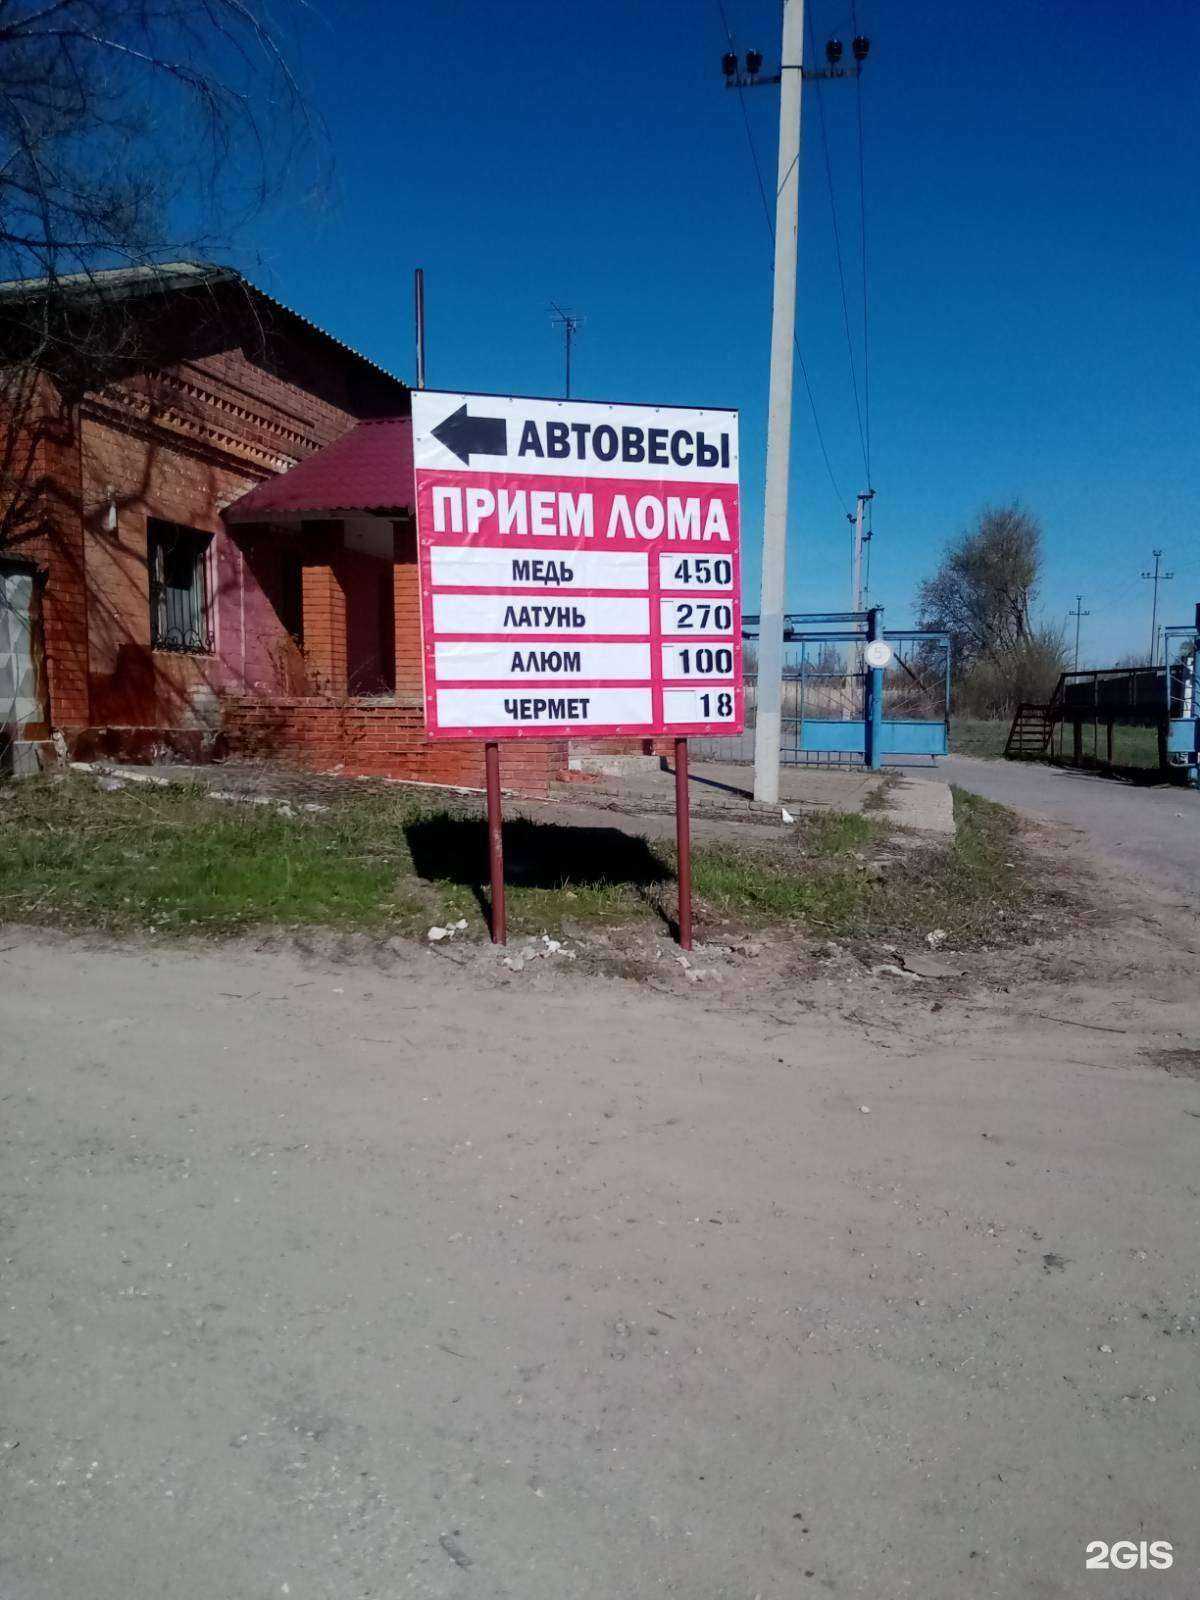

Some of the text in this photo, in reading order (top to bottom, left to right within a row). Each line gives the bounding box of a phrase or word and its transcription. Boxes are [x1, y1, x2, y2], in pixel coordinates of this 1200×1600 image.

[518, 420, 730, 468] АВТОВЕСЫ
[432, 486, 731, 541] ПРИЕМ ЛОМА
[511, 559, 732, 586] МЕДЬ 450
[503, 604, 732, 630] ЛАТУНЬ 270
[511, 648, 733, 674] АЛЮМ 100
[504, 693, 733, 720] ЧЕРМЕТ 18
